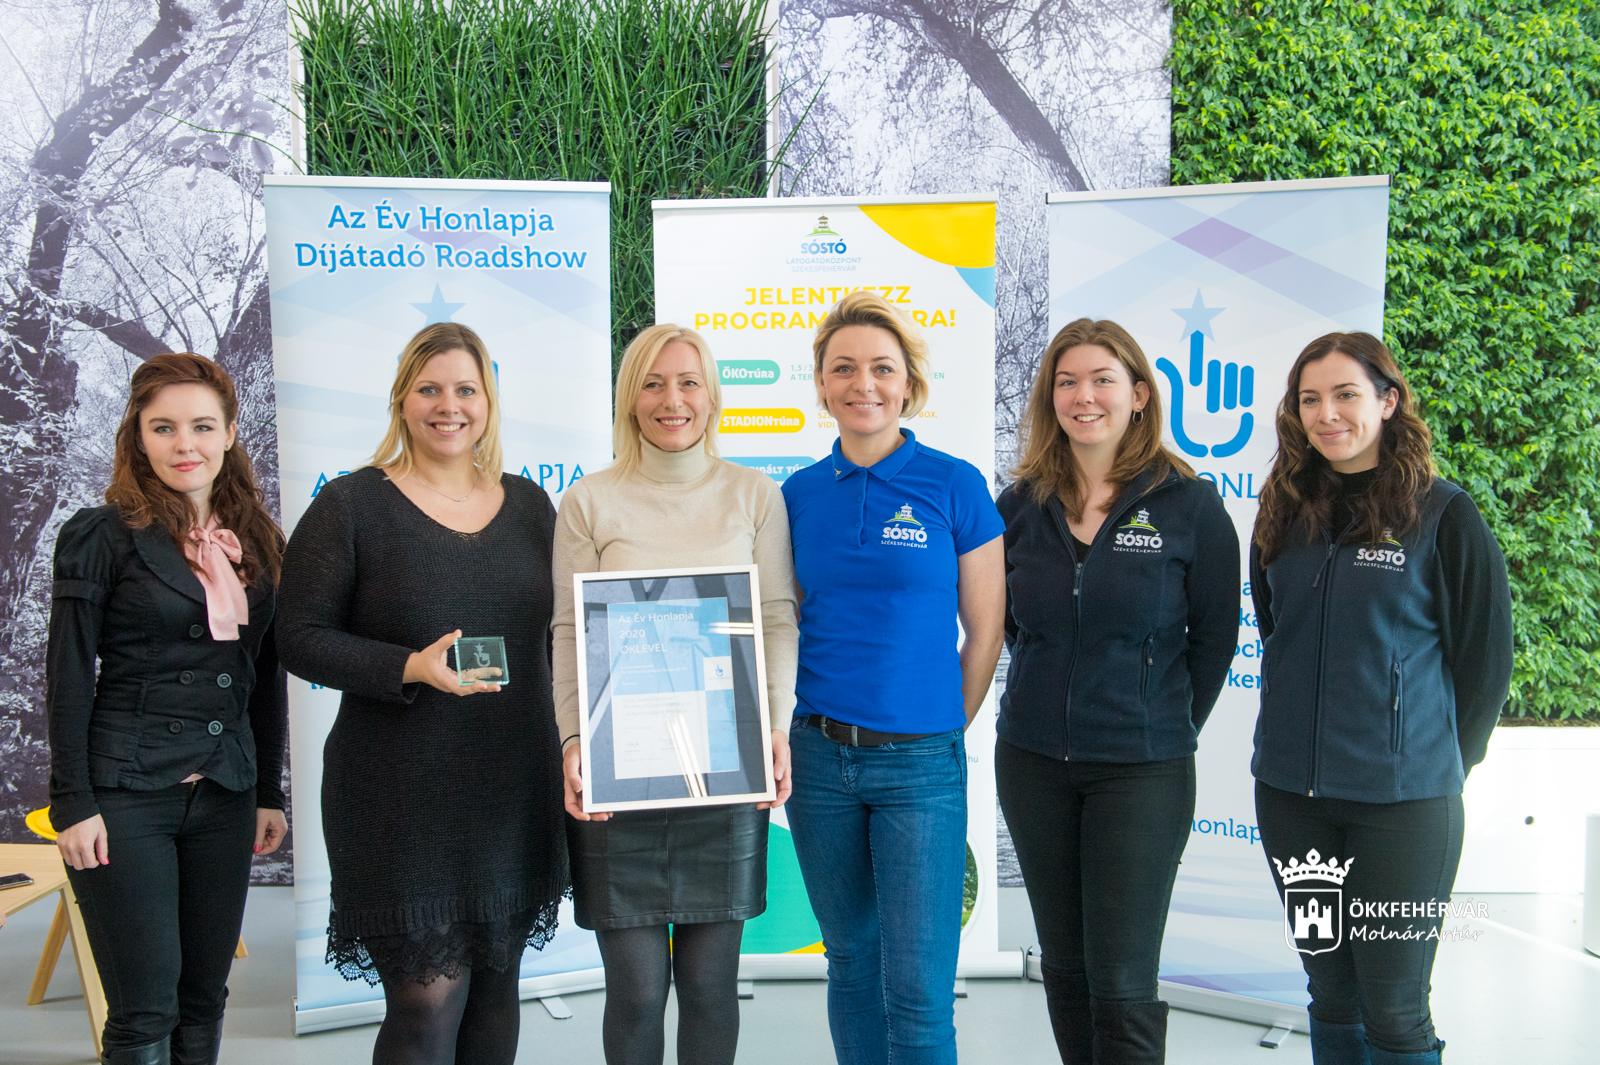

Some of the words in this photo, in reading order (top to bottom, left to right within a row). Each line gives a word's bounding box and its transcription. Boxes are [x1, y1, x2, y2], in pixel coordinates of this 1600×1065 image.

[327, 204, 366, 230] Az
[375, 199, 411, 230] Év
[419, 206, 555, 236] Honlapja
[800, 238, 847, 255] SÓSTÓ
[294, 242, 426, 274] Díjátadó
[434, 244, 588, 269] Roadshow
[744, 286, 911, 306] JELENTZZ
[790, 364, 803, 372] 1,5
[790, 373, 796, 381] A
[817, 421, 835, 429] VIDI
[882, 523, 928, 543] SÓSTÓ
[1114, 530, 1163, 549] SÓSTÓ
[618, 614, 632, 624] Az
[634, 612, 646, 623] Év
[648, 611, 694, 623] Honlapja
[619, 629, 646, 639] 2020
[620, 642, 668, 655] OKLEVÉL
